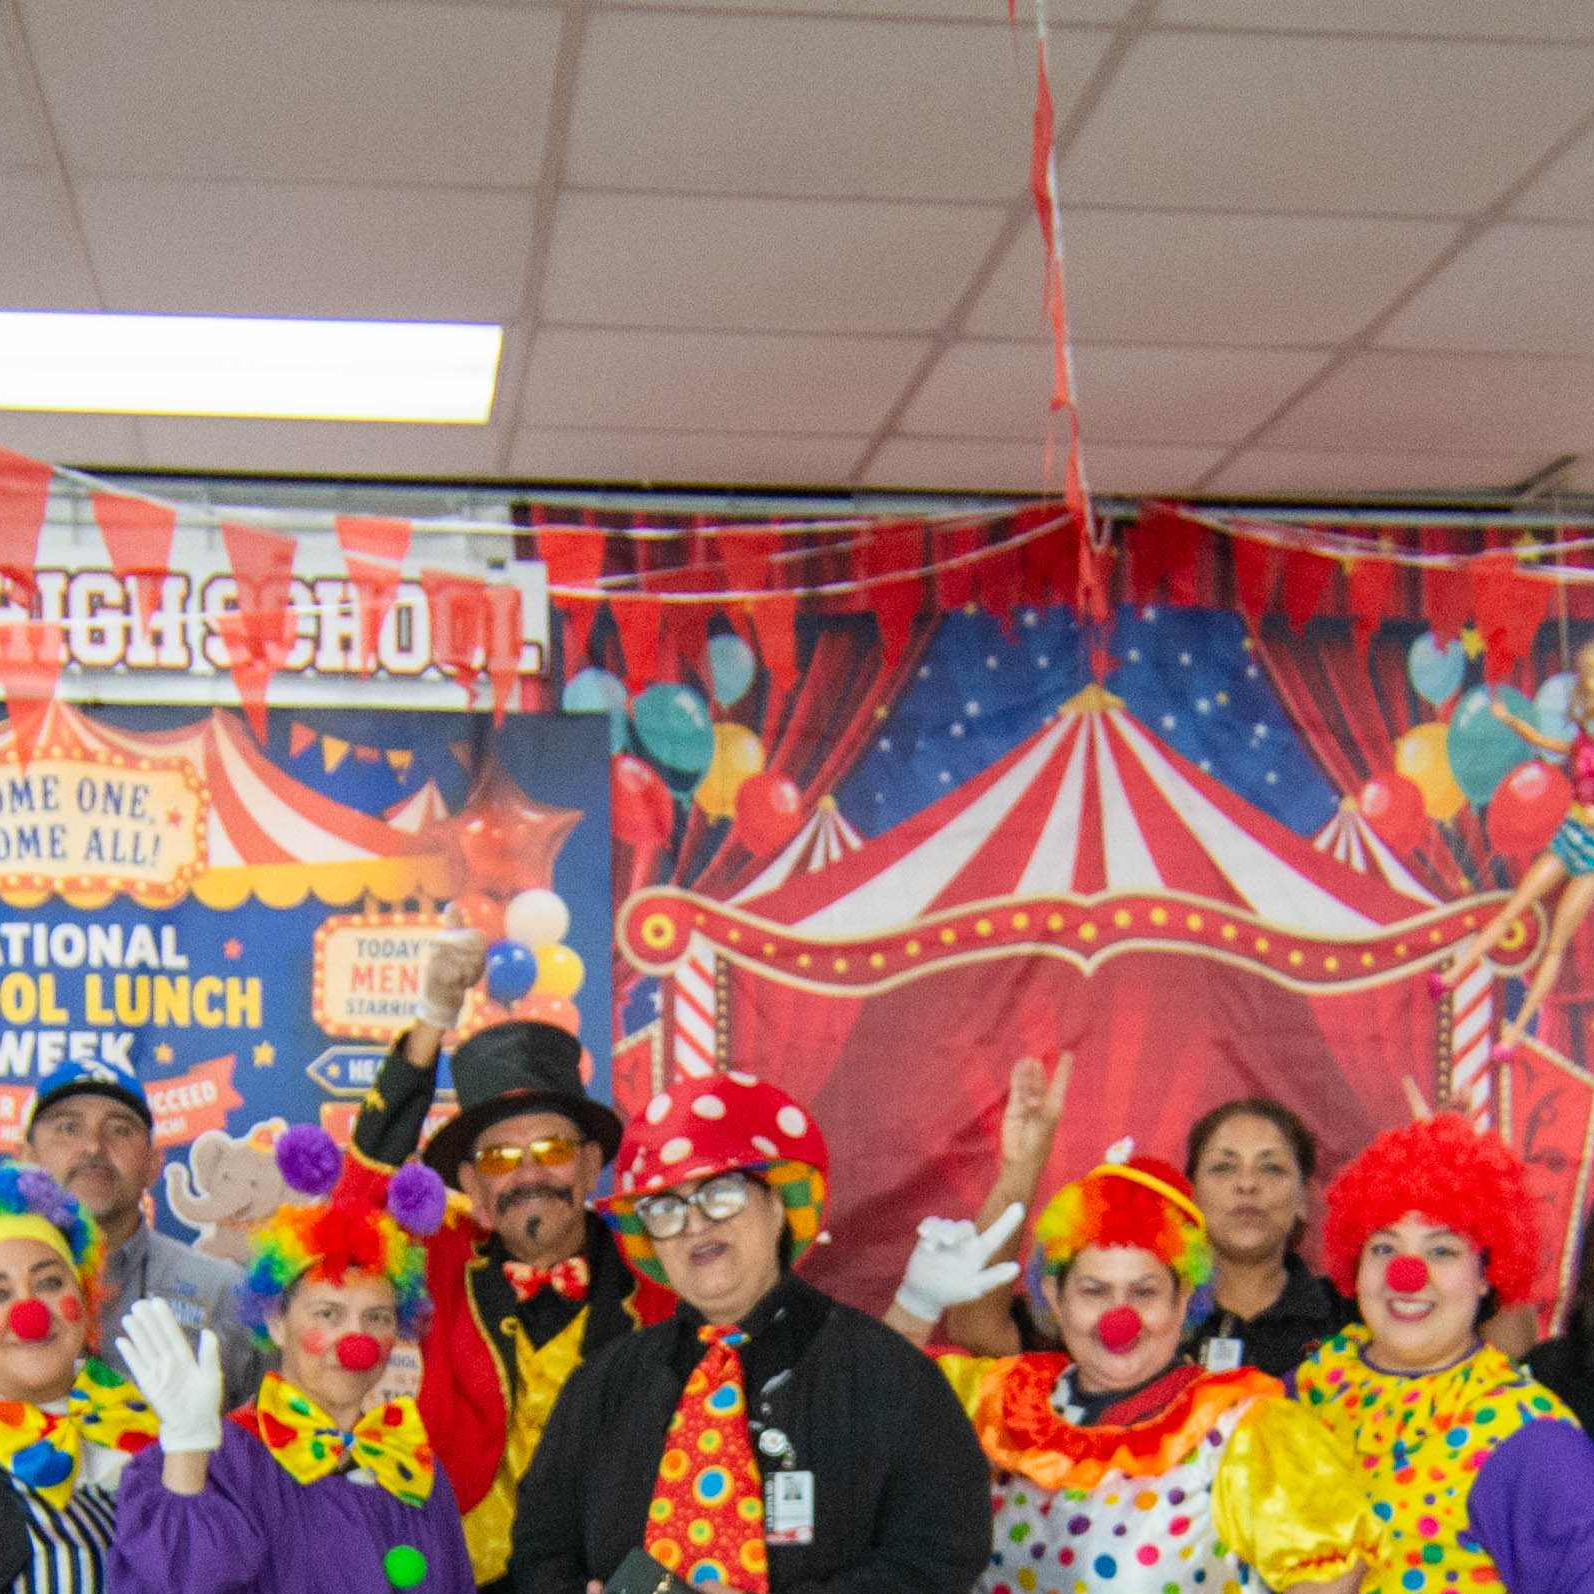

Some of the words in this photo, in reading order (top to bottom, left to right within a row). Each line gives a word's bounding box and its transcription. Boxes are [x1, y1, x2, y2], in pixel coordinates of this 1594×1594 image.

[76, 776, 156, 825] ONE,
[83, 826, 161, 868] ALL!
[85, 973, 263, 1029] LUNCH
